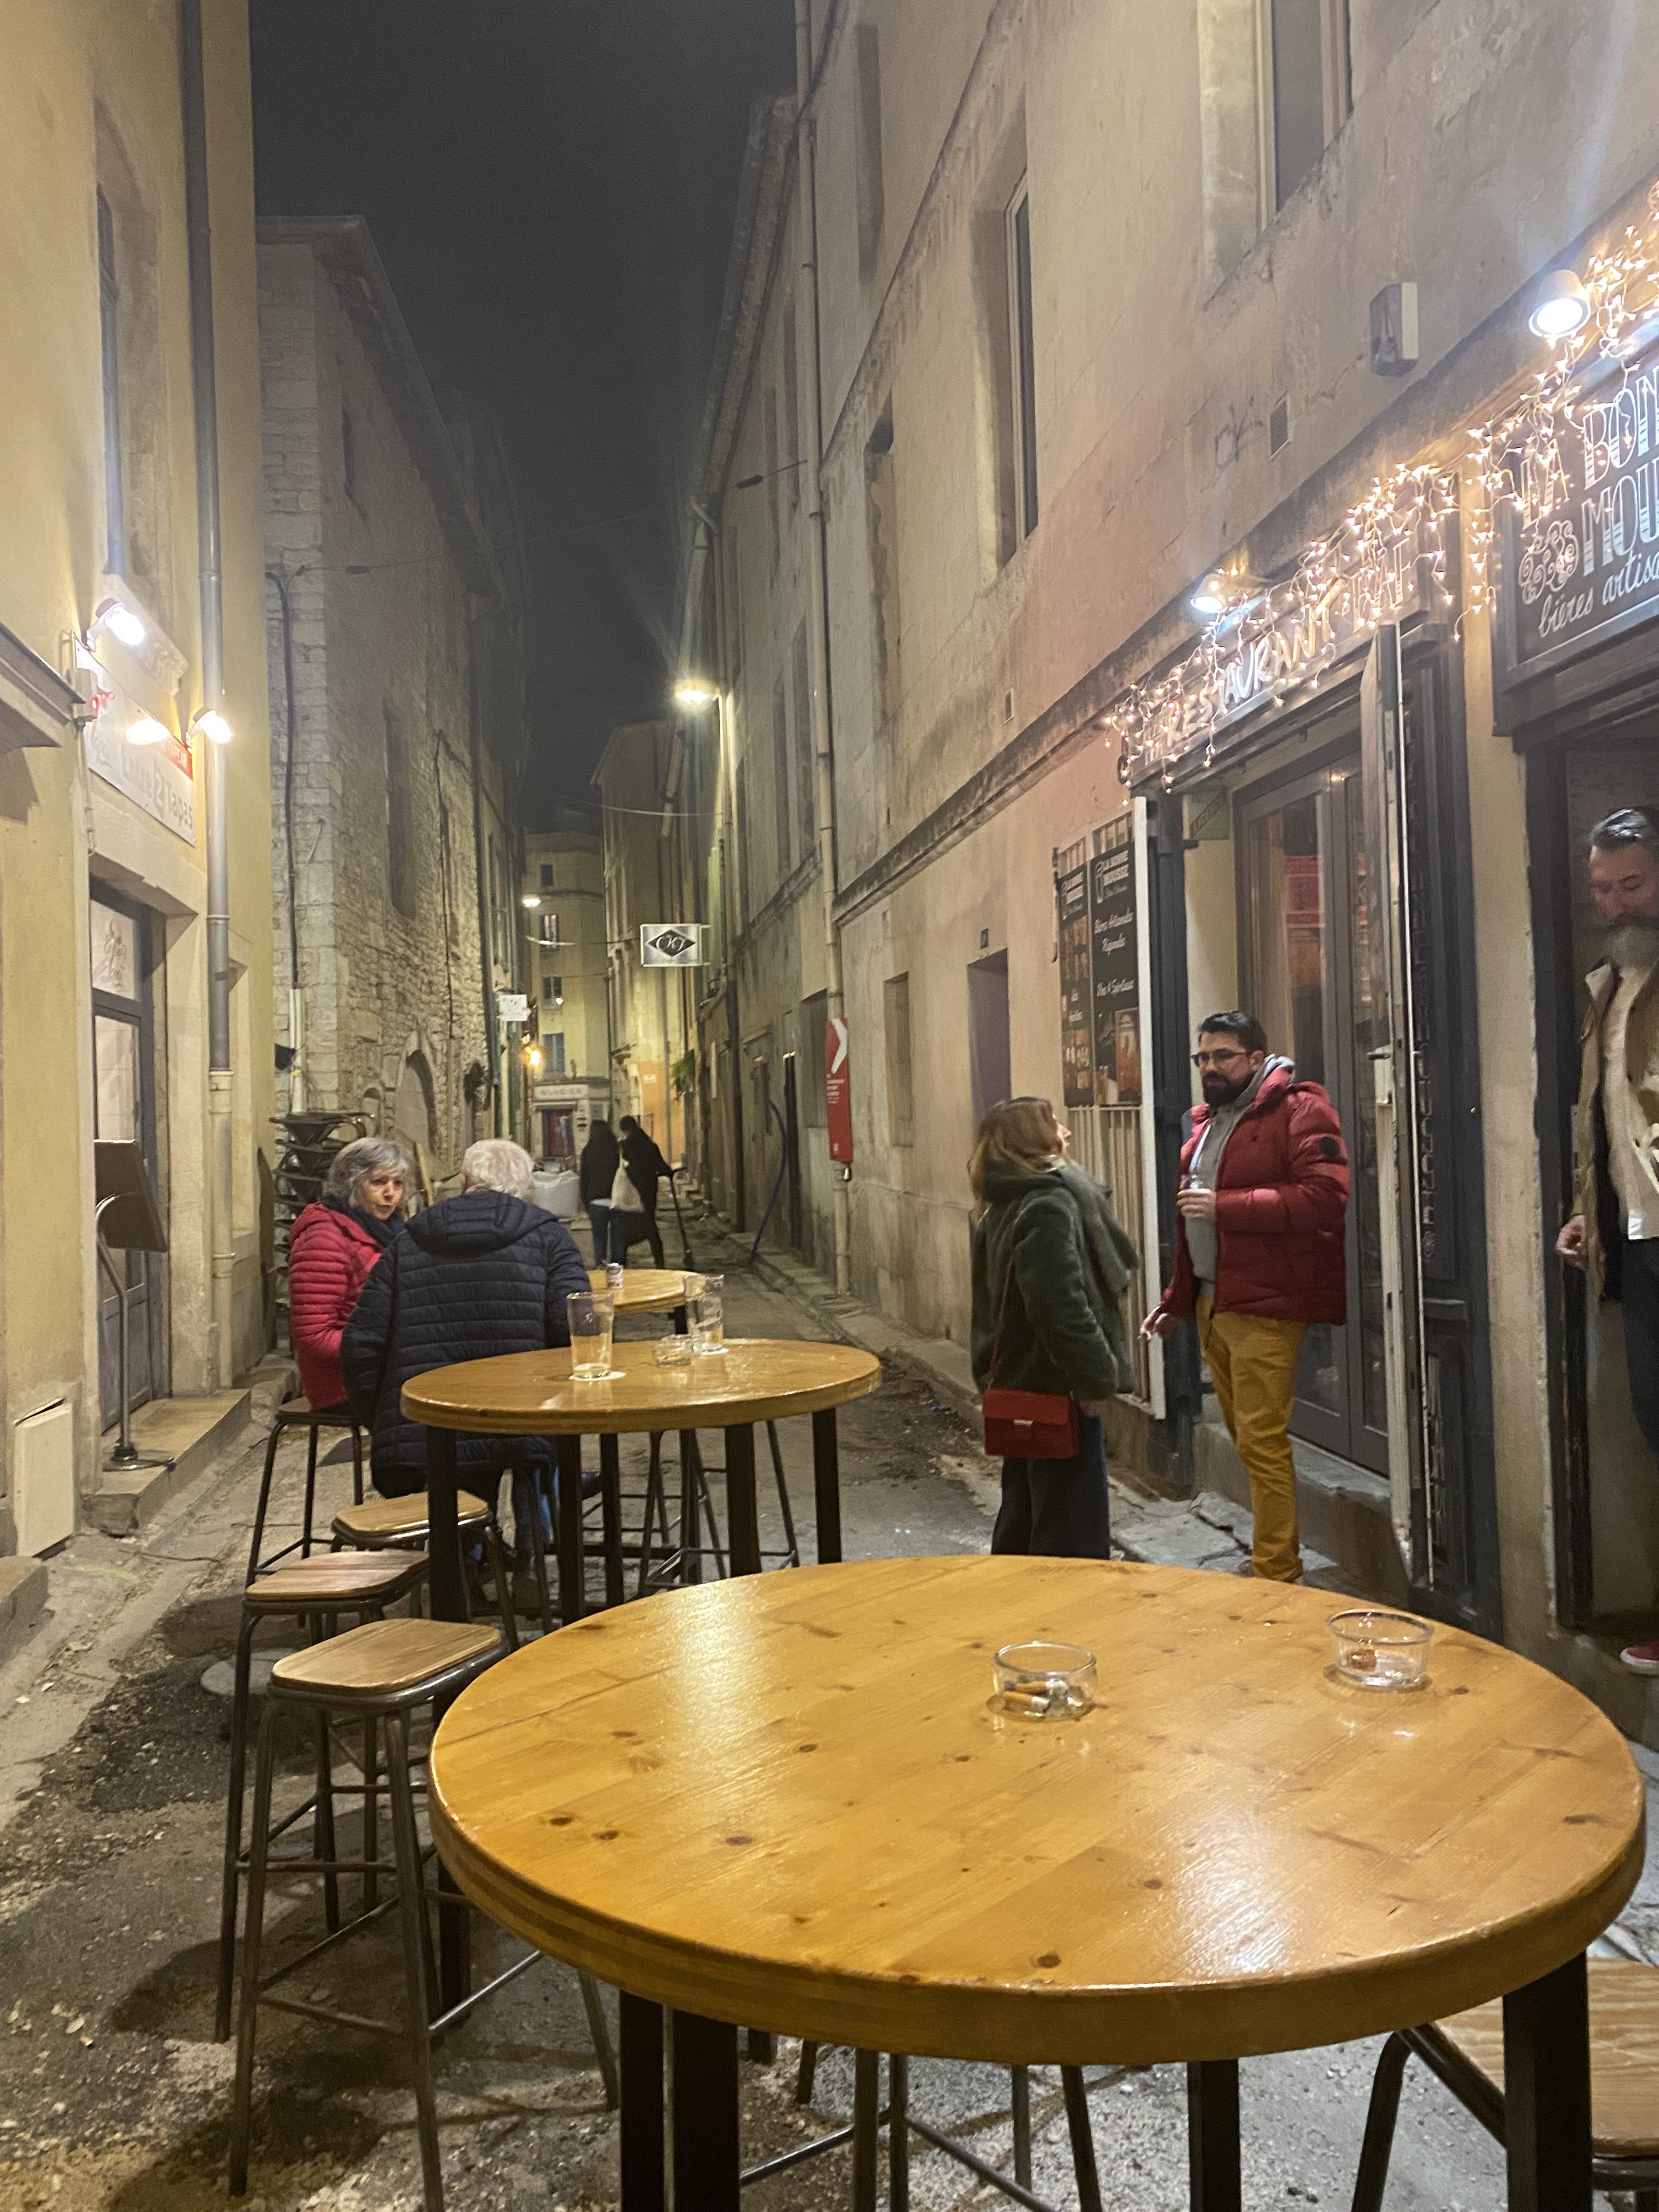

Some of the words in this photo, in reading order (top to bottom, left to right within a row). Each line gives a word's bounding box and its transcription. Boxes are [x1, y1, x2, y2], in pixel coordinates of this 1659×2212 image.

[1520, 438, 1570, 531] LA
[1162, 578, 1344, 747] RESTAURANT
[166, 781, 192, 830] Tapas
